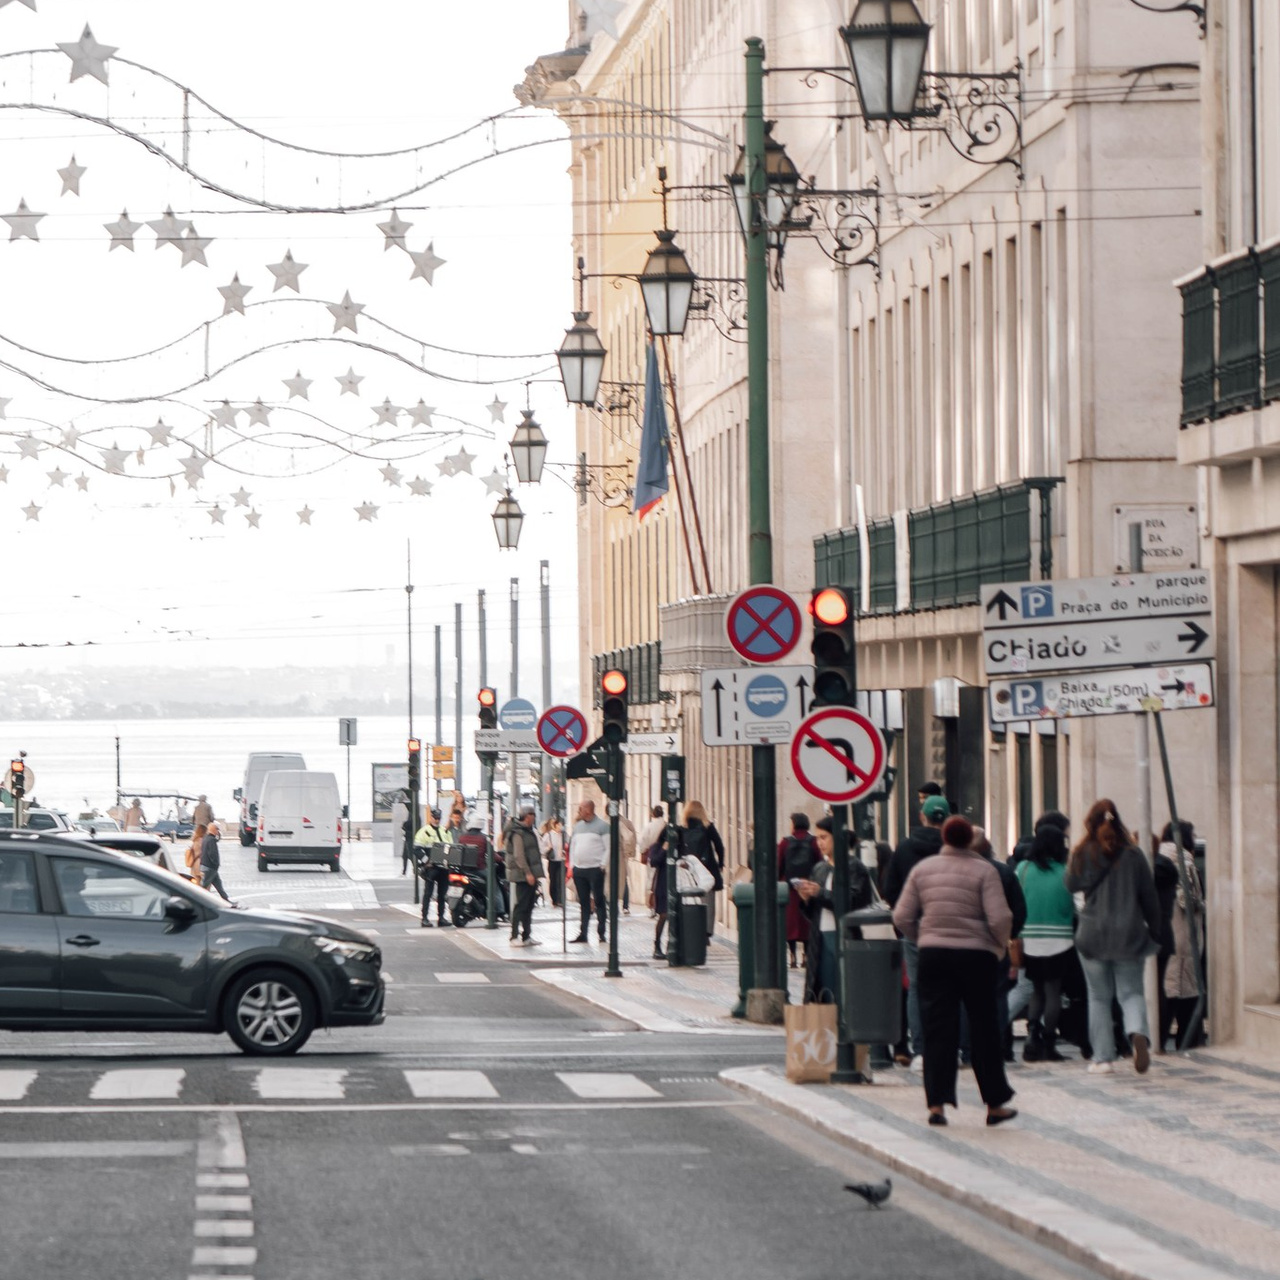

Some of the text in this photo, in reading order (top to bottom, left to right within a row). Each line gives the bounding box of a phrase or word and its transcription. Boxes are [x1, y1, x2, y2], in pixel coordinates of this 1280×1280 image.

[1144, 520, 1166, 528] RUA
[1148, 534, 1163, 542] DA
[1156, 575, 1207, 589] parque
[1061, 601, 1102, 616] Praça
[1111, 599, 1128, 611] do
[988, 636, 1088, 663] Chiado
